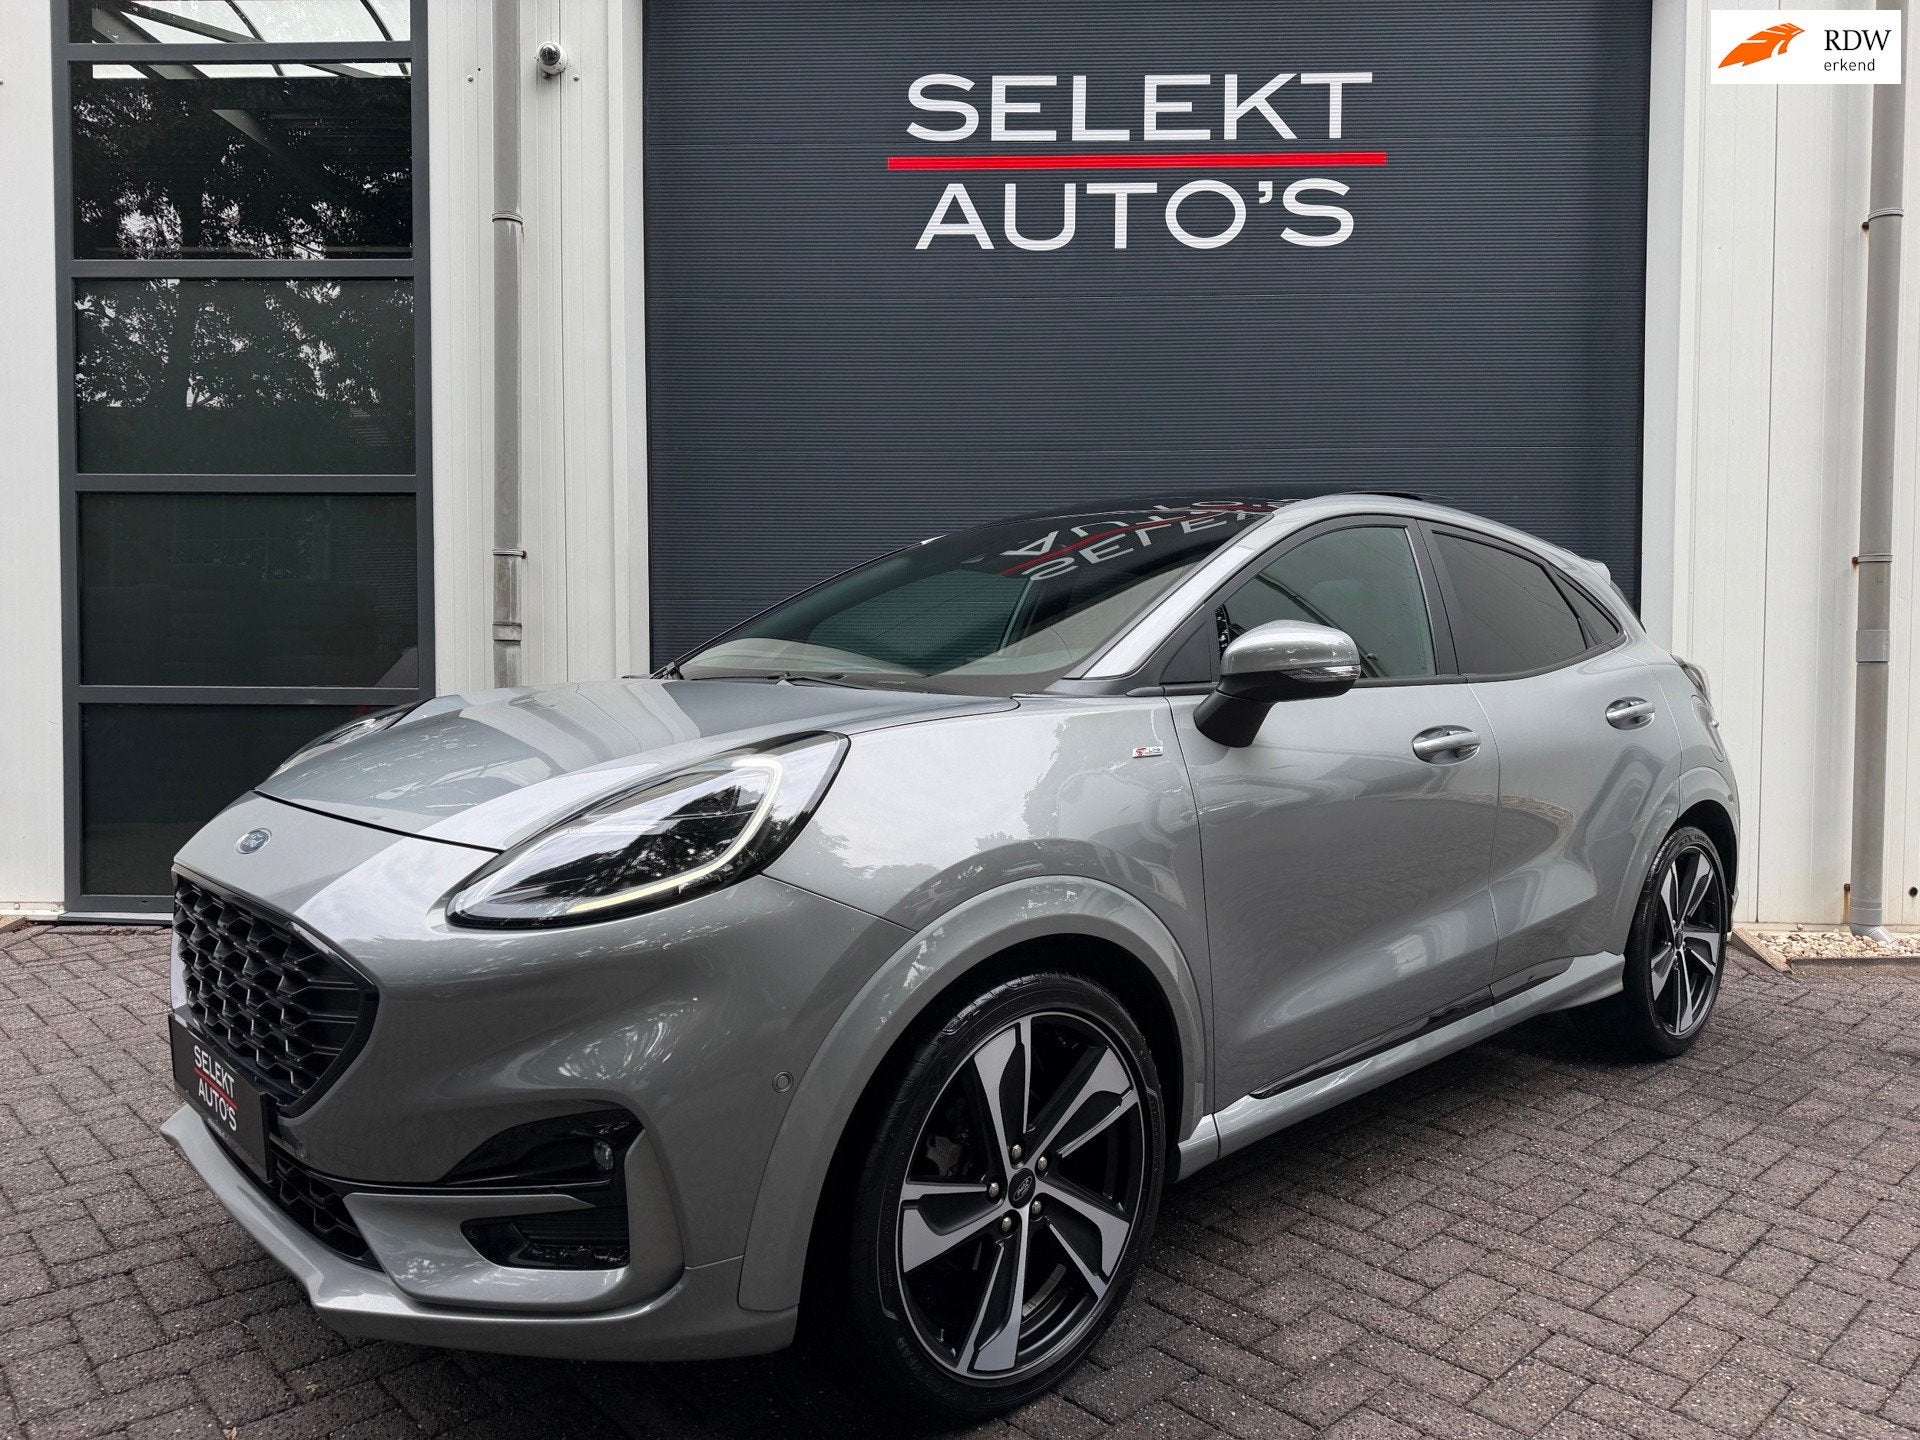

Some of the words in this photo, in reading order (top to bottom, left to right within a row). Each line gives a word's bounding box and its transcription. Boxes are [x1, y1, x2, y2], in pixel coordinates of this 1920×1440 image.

[906, 72, 1373, 142] SELEKT
[915, 178, 1355, 251] AUTO'S
[194, 1045, 234, 1098] SELEKT
[198, 1078, 237, 1131] AUTO'S
